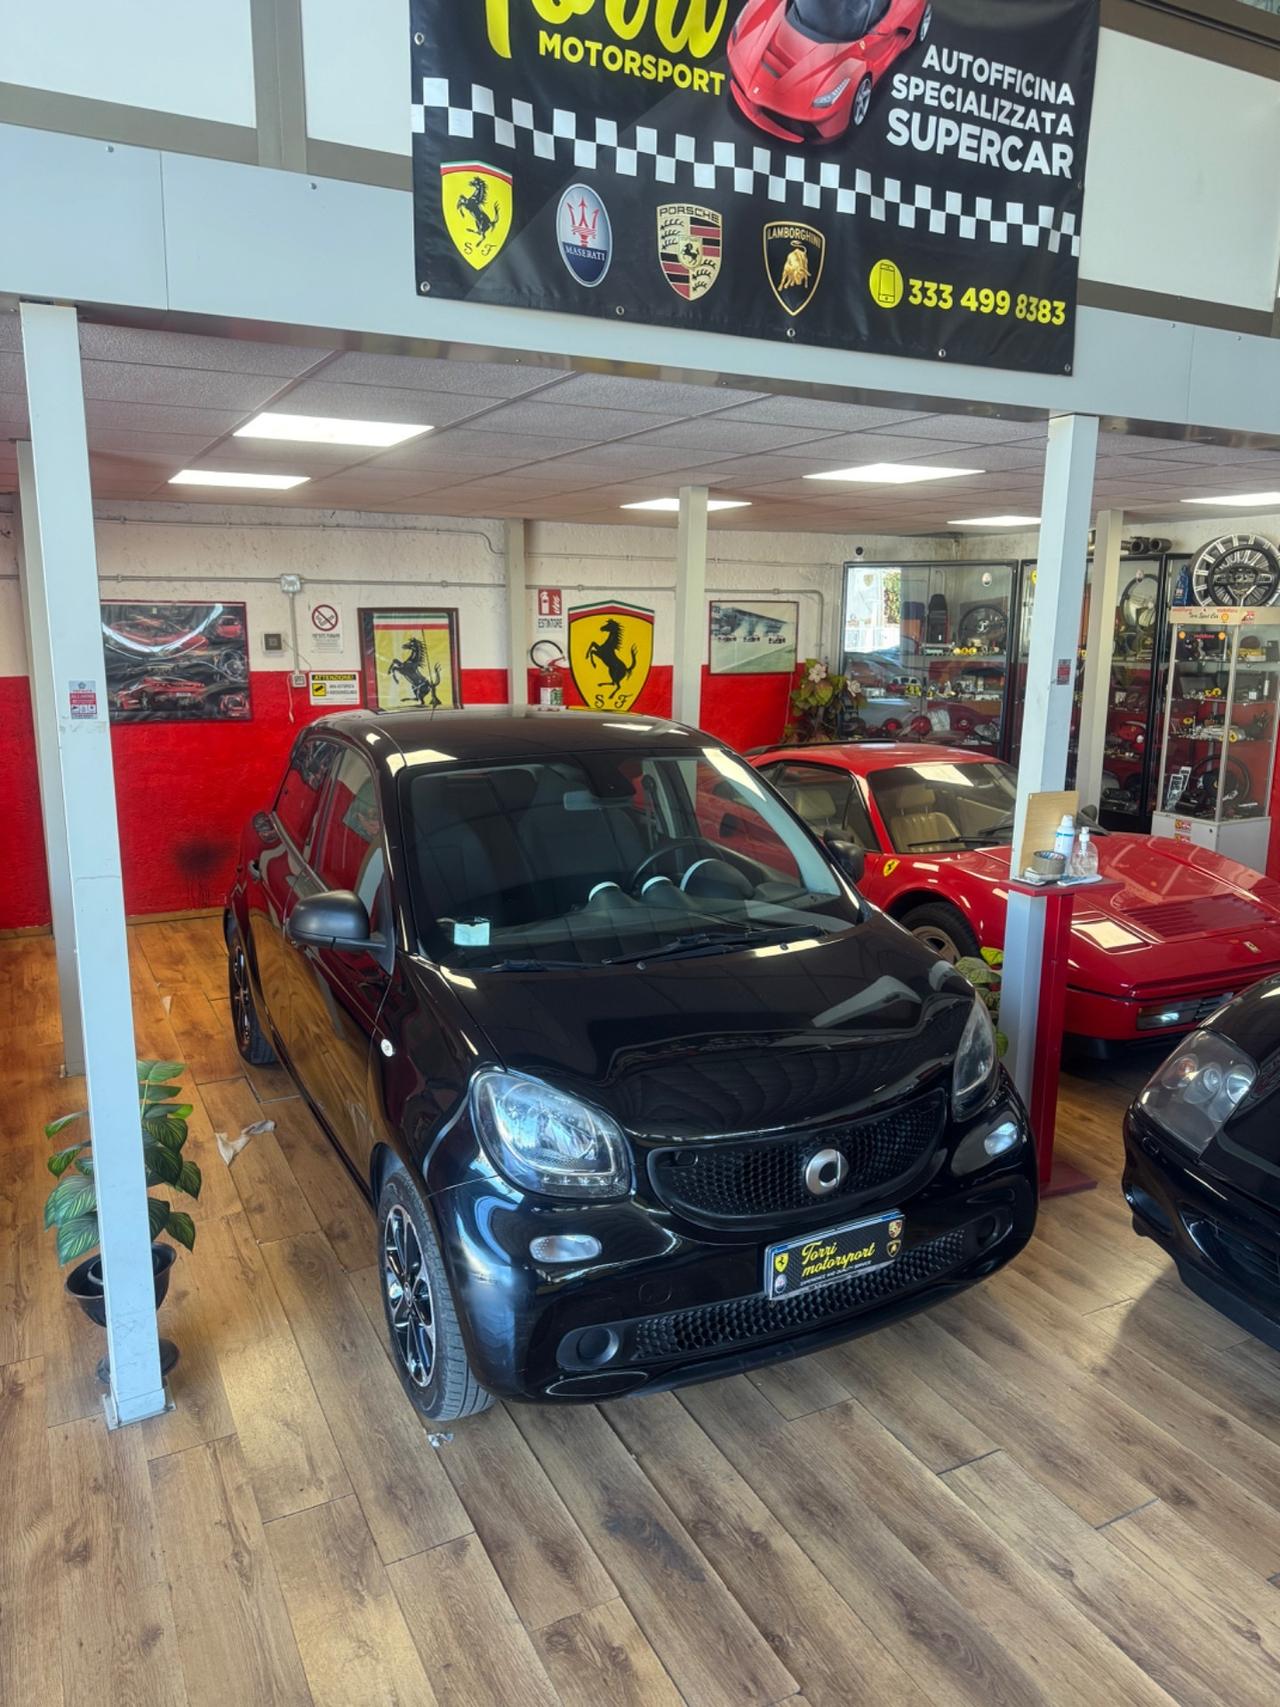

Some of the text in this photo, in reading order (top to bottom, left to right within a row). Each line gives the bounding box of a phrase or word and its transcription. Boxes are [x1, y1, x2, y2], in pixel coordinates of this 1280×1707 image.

[538, 30, 726, 96] MOTORSPORT
[921, 44, 1076, 106] AUTOFFICINA
[890, 73, 1074, 137] SPECIALIZZATA
[886, 107, 1074, 179] SUPERCAR
[659, 205, 720, 224] PORSCHE
[564, 244, 606, 262] MASERATI
[767, 226, 822, 249] LAMBORGHINI
[908, 278, 1067, 326] 333 499 8383
[594, 694, 605, 709] S
[801, 1240, 838, 1265] Torri
[801, 1241, 877, 1278] motorsport
